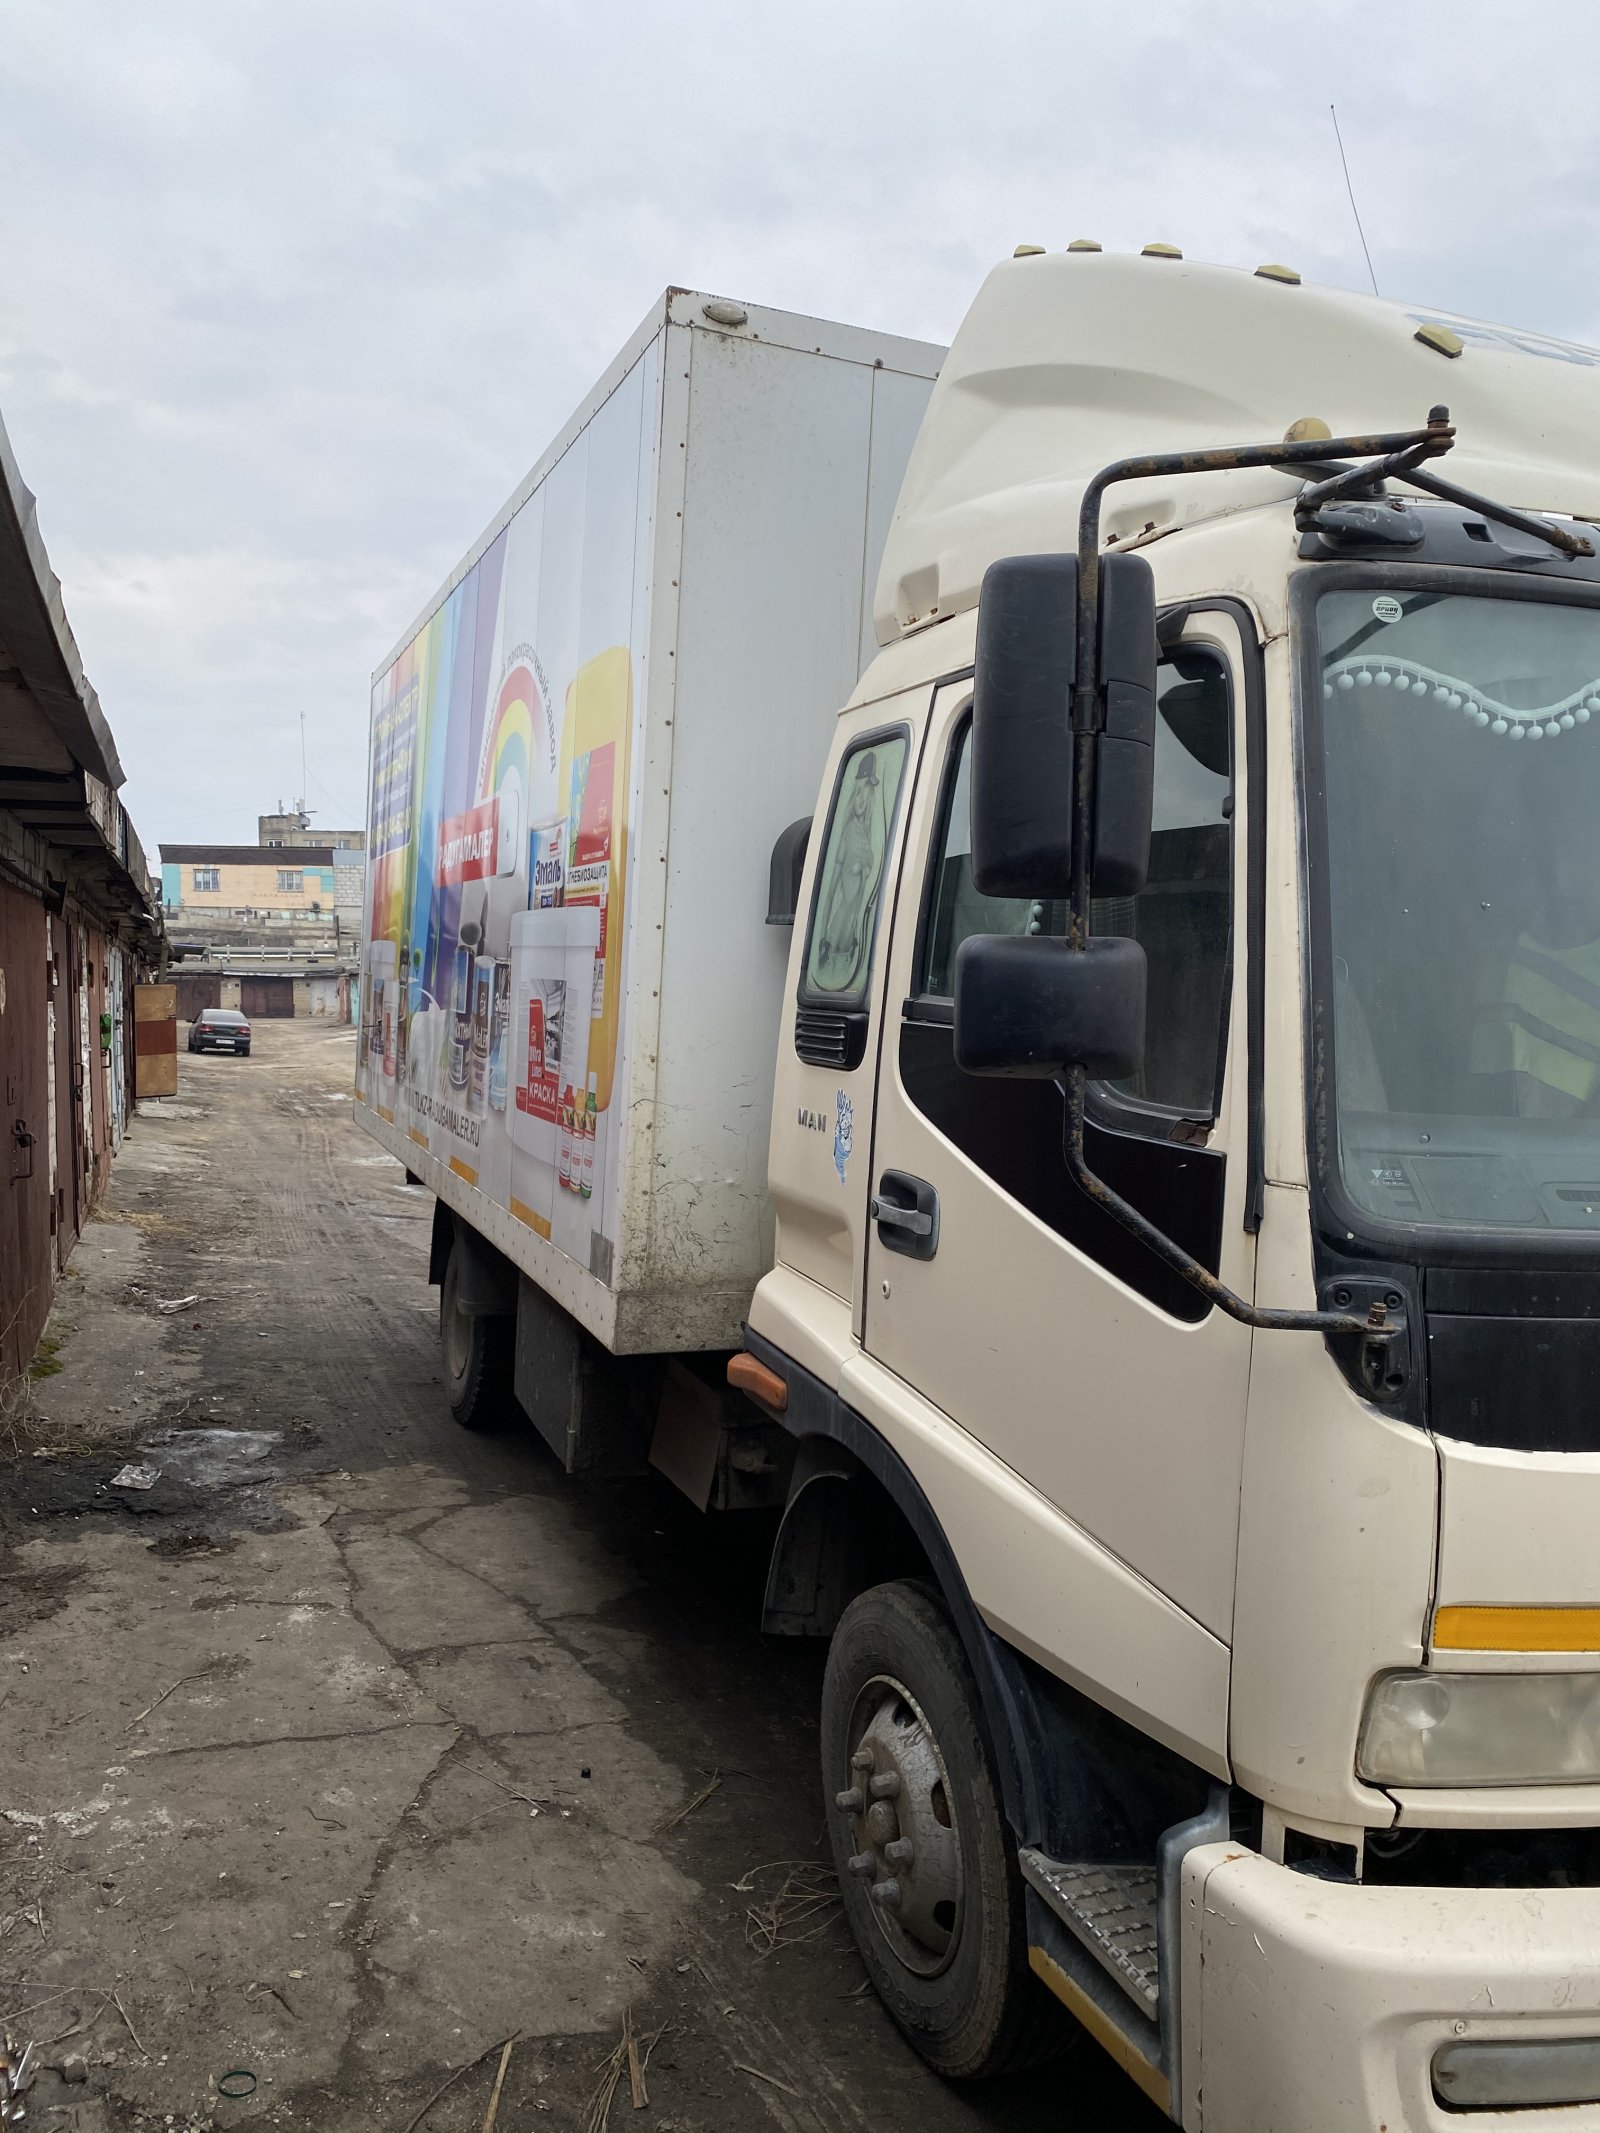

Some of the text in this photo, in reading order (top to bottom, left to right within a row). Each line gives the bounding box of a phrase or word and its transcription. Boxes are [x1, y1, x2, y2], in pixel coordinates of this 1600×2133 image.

[545, 700, 557, 773] завод
[529, 1081, 556, 1107] КРАСКА
[797, 1107, 827, 1132] MAN
